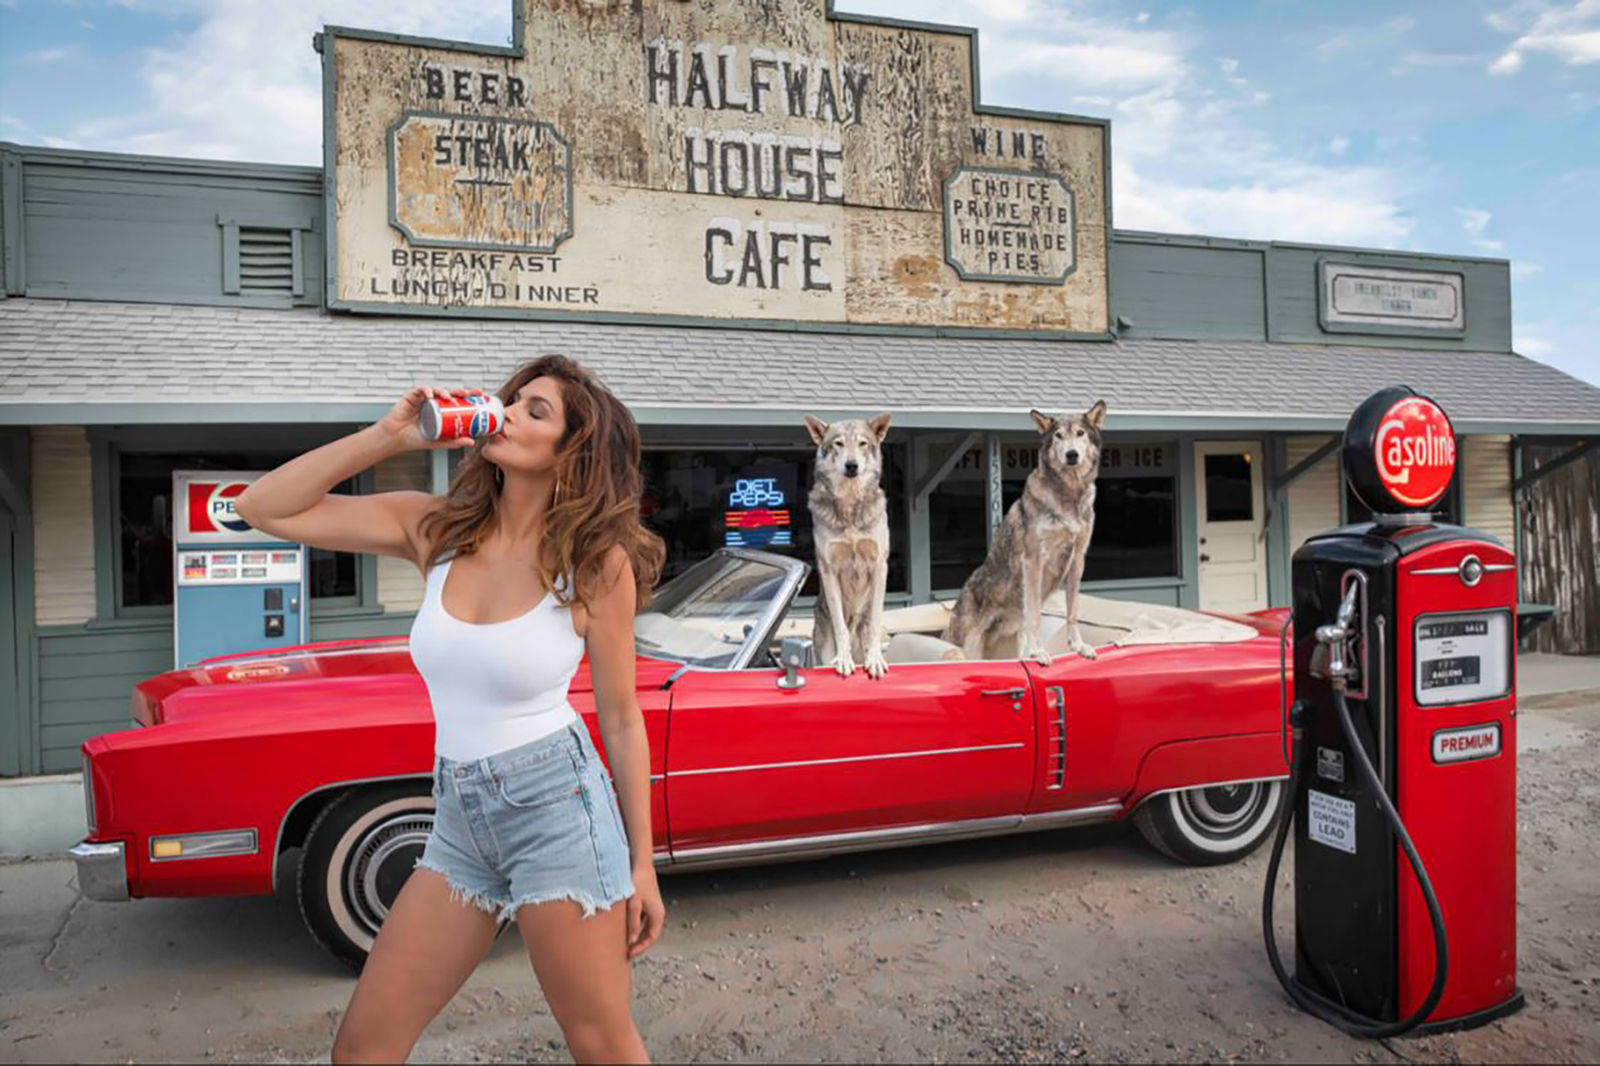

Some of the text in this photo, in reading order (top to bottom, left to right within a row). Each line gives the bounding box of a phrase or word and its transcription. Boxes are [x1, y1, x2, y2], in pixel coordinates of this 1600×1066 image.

[425, 67, 528, 108] BEER
[646, 46, 870, 125] HALFWAY
[434, 135, 530, 171] STEAK
[971, 127, 1046, 161] WINE
[685, 136, 844, 202] HOUSE
[972, 178, 1050, 201] CHOICE
[953, 199, 1067, 224] PRIME RIB
[960, 228, 1067, 251] HOMEMADE
[391, 249, 562, 273] BREAKFAST
[705, 227, 832, 292] CAFE
[988, 251, 1040, 272] PIES
[1134, 448, 1163, 467] ICE
[1375, 419, 1455, 484] Gasoline
[736, 479, 776, 493] DIET
[1441, 733, 1493, 752] PREMIUM
[1318, 823, 1345, 840] LEAD
